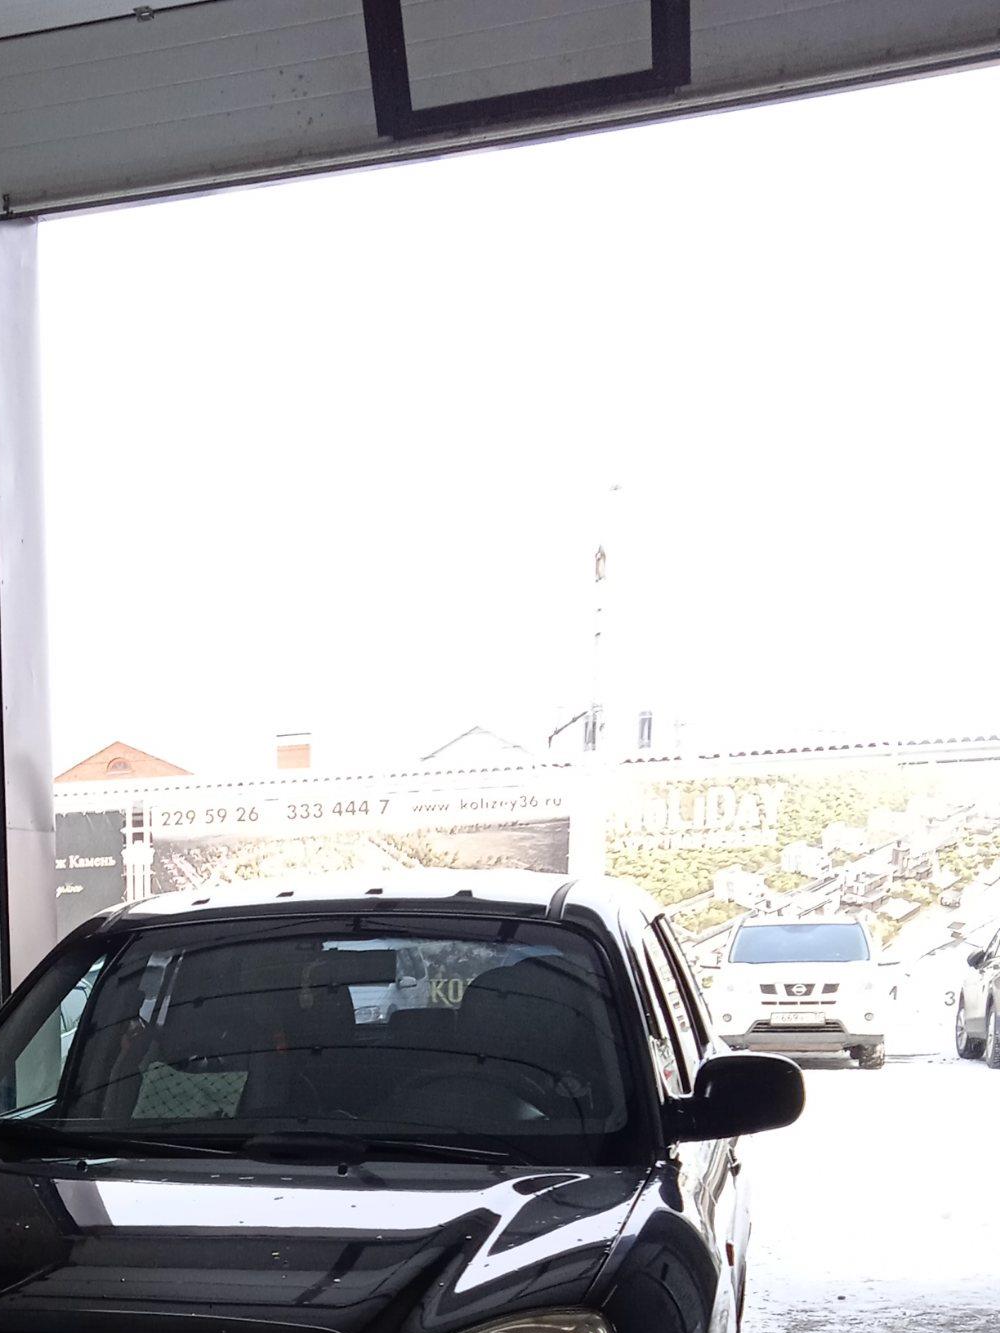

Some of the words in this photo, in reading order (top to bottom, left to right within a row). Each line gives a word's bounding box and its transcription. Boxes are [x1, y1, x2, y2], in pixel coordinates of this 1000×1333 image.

[161, 809, 196, 826] 229
[205, 807, 227, 824] 59
[236, 806, 259, 822] 26
[287, 802, 324, 819] 333
[332, 800, 370, 817] 444
[379, 799, 390, 815] 7
